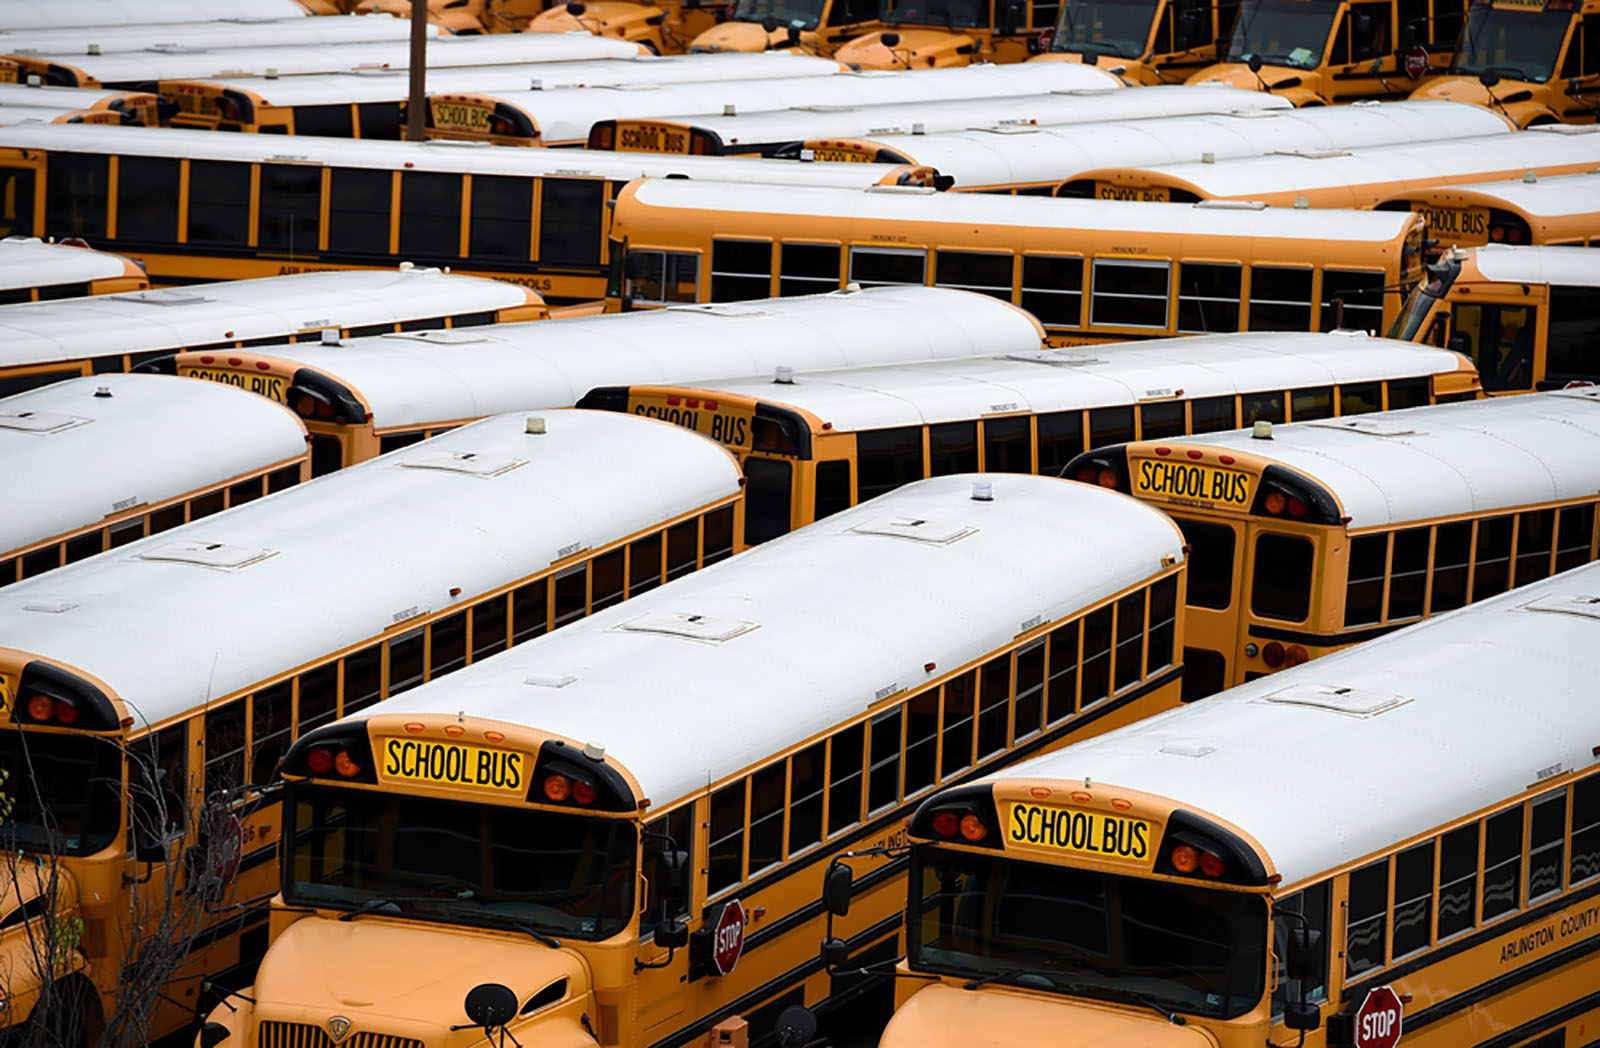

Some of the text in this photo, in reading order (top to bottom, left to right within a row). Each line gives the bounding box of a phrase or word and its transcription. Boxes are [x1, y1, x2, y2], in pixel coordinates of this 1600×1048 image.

[437, 104, 489, 129] SCHOOL BUS
[621, 129, 684, 153] SCHOOL BUS
[1462, 212, 1485, 235] BUS
[711, 414, 747, 446] BUS
[1140, 461, 1248, 503] SCHOOL BUS
[387, 740, 521, 789] SCHOOL BUS
[1012, 804, 1148, 858] SCHOOL BUS
[719, 920, 741, 954] STOP
[1500, 906, 1600, 965] ARLINGTON COUNTY
[1362, 1008, 1396, 1041] STOP
